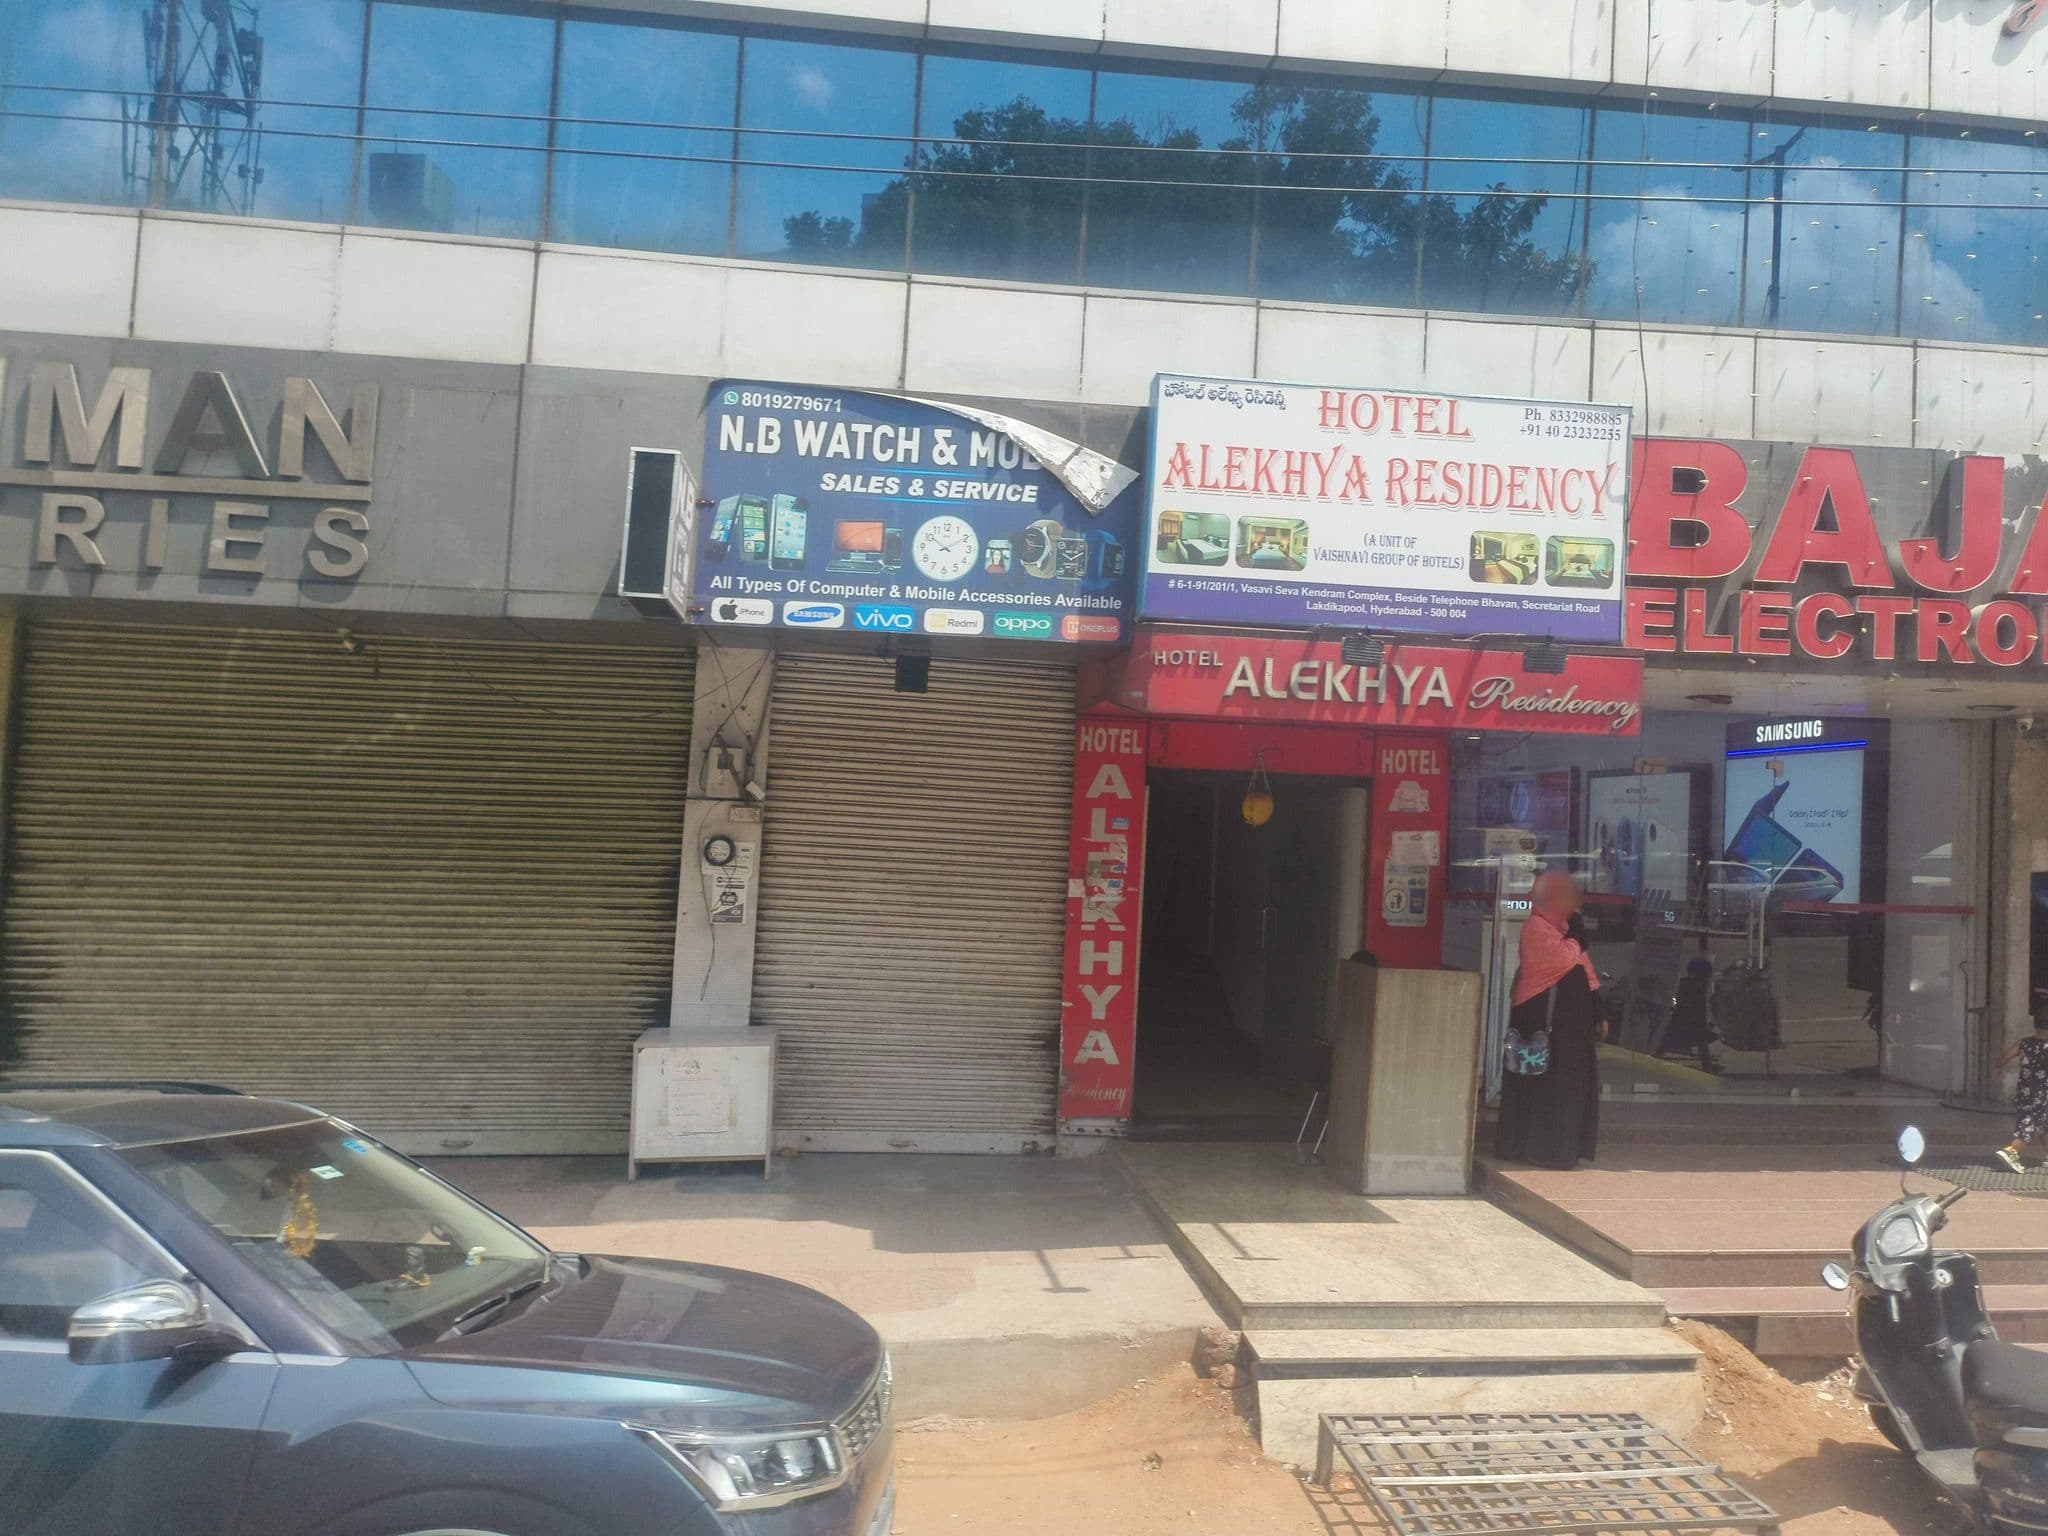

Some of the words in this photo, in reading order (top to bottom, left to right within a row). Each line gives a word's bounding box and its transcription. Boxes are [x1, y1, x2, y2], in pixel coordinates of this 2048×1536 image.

[741, 391, 842, 413] 8019279671
[1317, 390, 1472, 438] HOTEL
[0, 357, 380, 483] MAN
[1519, 423, 1541, 437] +91
[1545, 425, 1560, 438] 40
[1549, 409, 1622, 426] 8332988885
[719, 414, 781, 457] N.B
[794, 419, 920, 463] WATCH
[931, 429, 958, 466] &
[820, 472, 899, 497] SALES
[908, 478, 925, 497] &
[932, 478, 1039, 503] SERVICE
[1162, 442, 1374, 504] ALEKHYA
[1384, 457, 1617, 518] RESIDENCY
[1626, 437, 2048, 596] BAJ
[37, 492, 370, 578] RIES
[1379, 534, 1402, 549] UNIT
[1404, 536, 1418, 549] OF
[1313, 547, 1369, 564] VAISHNAVI
[1371, 552, 1405, 567] GROUP
[1407, 554, 1421, 567] OF
[710, 575, 732, 591] All
[736, 576, 782, 594] Types
[787, 578, 806, 594] Of
[809, 580, 886, 598] Computer
[889, 585, 901, 599] &
[905, 585, 955, 602] Mobile
[958, 588, 1051, 606] Accessories
[1054, 593, 1122, 610] Available
[1241, 583, 1273, 595] Vasavi
[1275, 585, 1299, 597] Seva
[1301, 587, 1345, 599] Kendram
[1395, 592, 1428, 604] Beside
[1431, 594, 1480, 607] Telephone
[1522, 599, 1574, 612] Secretariat
[1575, 602, 1601, 614] Road
[947, 618, 978, 628] Redmi
[1306, 600, 1368, 615] Lakdikapool,
[1370, 604, 1422, 618] Hyderabad
[1430, 608, 1448, 618] 500
[1623, 585, 2048, 667] ELECTRO
[1154, 650, 1224, 666] HOTEL
[1223, 656, 1454, 708] ALEKHYA
[1469, 676, 1640, 729] Residency
[1079, 727, 1143, 755] HOTEL
[1756, 719, 1823, 743] SAMSUNG
[1381, 749, 1441, 776] HOTEL
[1664, 911, 1676, 923] 5G
